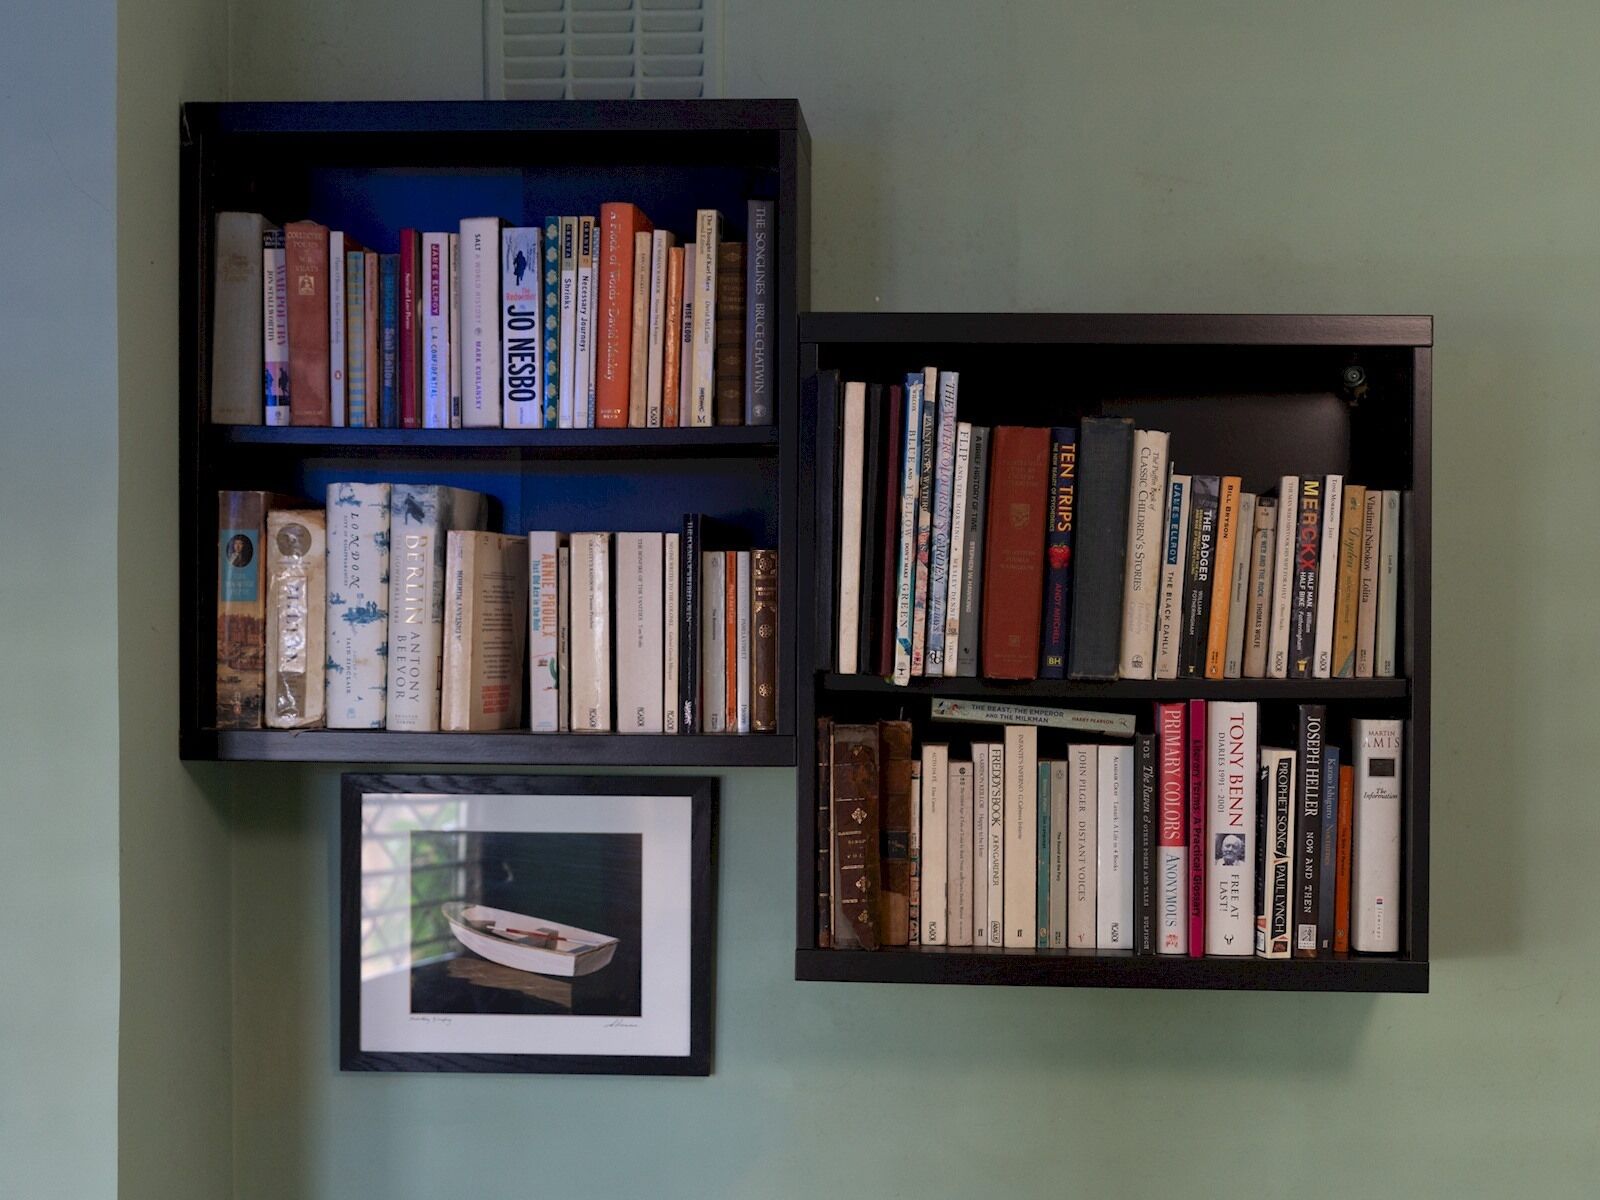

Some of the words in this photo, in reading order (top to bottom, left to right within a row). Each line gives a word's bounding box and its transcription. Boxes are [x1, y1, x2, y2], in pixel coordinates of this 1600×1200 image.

[754, 208, 766, 229] THE
[564, 224, 573, 258] GRANTA
[582, 222, 590, 256] GRANTA
[609, 224, 621, 252] Flock
[267, 270, 275, 284] JON
[431, 244, 439, 276] JAMES
[610, 254, 620, 266] of
[754, 232, 766, 295] SONGLINES
[277, 264, 286, 292] WAR
[564, 278, 572, 309] Shrinks
[579, 276, 588, 314] Necessary
[431, 280, 439, 315] ELLROY
[508, 304, 535, 330] JO
[608, 304, 620, 338] David
[754, 303, 766, 338] BRUCE
[384, 328, 394, 350] Saul
[579, 318, 588, 352] Journeys
[384, 353, 394, 386] Bellow
[754, 339, 766, 394] CHATWIN
[944, 382, 956, 408] THE
[907, 429, 918, 463] BLUE
[974, 444, 982, 465] BRIEF
[1060, 442, 1076, 478] TEN
[936, 408, 954, 530] WATERCOLOURIST'S
[972, 466, 980, 500] HISTORY
[1139, 447, 1151, 488] CLASSIC
[1150, 466, 1158, 486] Puffin
[972, 502, 980, 512] OF
[1056, 484, 1074, 532] TRIPS
[1149, 503, 1156, 512] of
[1172, 484, 1182, 519] JAMES
[1226, 484, 1234, 503] BILL
[902, 484, 916, 538] YELLOW
[970, 513, 978, 532] TIME
[1134, 490, 1149, 550] CHILDREN'S
[1202, 510, 1212, 532] THE
[1223, 506, 1232, 538] BRYSON
[1298, 480, 1320, 570] MERCKX
[1365, 496, 1376, 534] Vladimir
[350, 512, 360, 590] LONDON
[934, 533, 946, 584] GARDEN
[968, 541, 976, 570] STEPHEN
[1170, 523, 1179, 562] ELLROY
[1198, 534, 1211, 582] BADGER
[1364, 535, 1374, 572] Nabokov
[405, 534, 428, 624] BERLIN
[542, 554, 555, 588] ANNIE
[1133, 552, 1146, 592] STORIES
[1306, 572, 1314, 590] HALF
[900, 583, 912, 628] GREEN
[965, 580, 974, 613] HAWKING
[1055, 584, 1063, 602] ANDY
[1164, 592, 1172, 620] BLACK
[1362, 578, 1372, 603] Lolita
[542, 594, 556, 638] PROULX
[1052, 604, 1062, 645] MITCHELL
[1189, 590, 1197, 636] FOTHERINGHAM
[1296, 609, 1305, 650] Fotheringham
[1162, 624, 1170, 656] DAHLIA
[396, 635, 406, 700] BEEVOR
[409, 632, 420, 704] ANTONY
[1276, 651, 1284, 672] PICADOR
[1320, 651, 1328, 672] PICADOR
[637, 707, 645, 727] PICADOR
[666, 710, 674, 730] PICADOR
[1030, 708, 1064, 718] EMPEROR
[1164, 710, 1181, 778] PRIMARY
[1228, 712, 1244, 770] TONY
[1306, 716, 1322, 765] JOSEPH
[1364, 737, 1400, 748] AMIS
[991, 749, 1001, 797] FREDDY'S
[1078, 751, 1086, 776] JOHN
[1143, 766, 1154, 785] The
[1192, 740, 1202, 778] Literary
[1326, 758, 1336, 784] Kazuo
[1078, 779, 1086, 812] PILGER
[1143, 786, 1153, 814] Raven
[1192, 780, 1201, 815] Terms:
[1229, 774, 1244, 827] BENN
[1278, 762, 1288, 814] PROPHET
[1305, 768, 1320, 816] HELLER
[1324, 786, 1334, 819] Ishiguro
[1363, 792, 1398, 800] Information
[992, 797, 1001, 827] BOOK
[1164, 780, 1180, 840] COLORS
[1193, 817, 1201, 826] A
[1078, 820, 1086, 862] DISTANT
[1276, 816, 1287, 848] SONG
[1306, 832, 1314, 854] NOW
[1324, 824, 1334, 866] Nocturnes
[1192, 827, 1201, 872] Practical
[1078, 866, 1086, 902] VOICES
[1276, 864, 1286, 893] PAUL
[1304, 858, 1313, 880] AND
[1166, 854, 1180, 927] ANONYMOUS
[1192, 874, 1201, 918] Glossary
[1220, 881, 1228, 912] LAST!
[1230, 874, 1240, 904] FREE
[1304, 884, 1312, 914] THEN
[1230, 906, 1240, 920] AT
[1275, 894, 1286, 933] LYNCH
[928, 922, 936, 942] PICADOR
